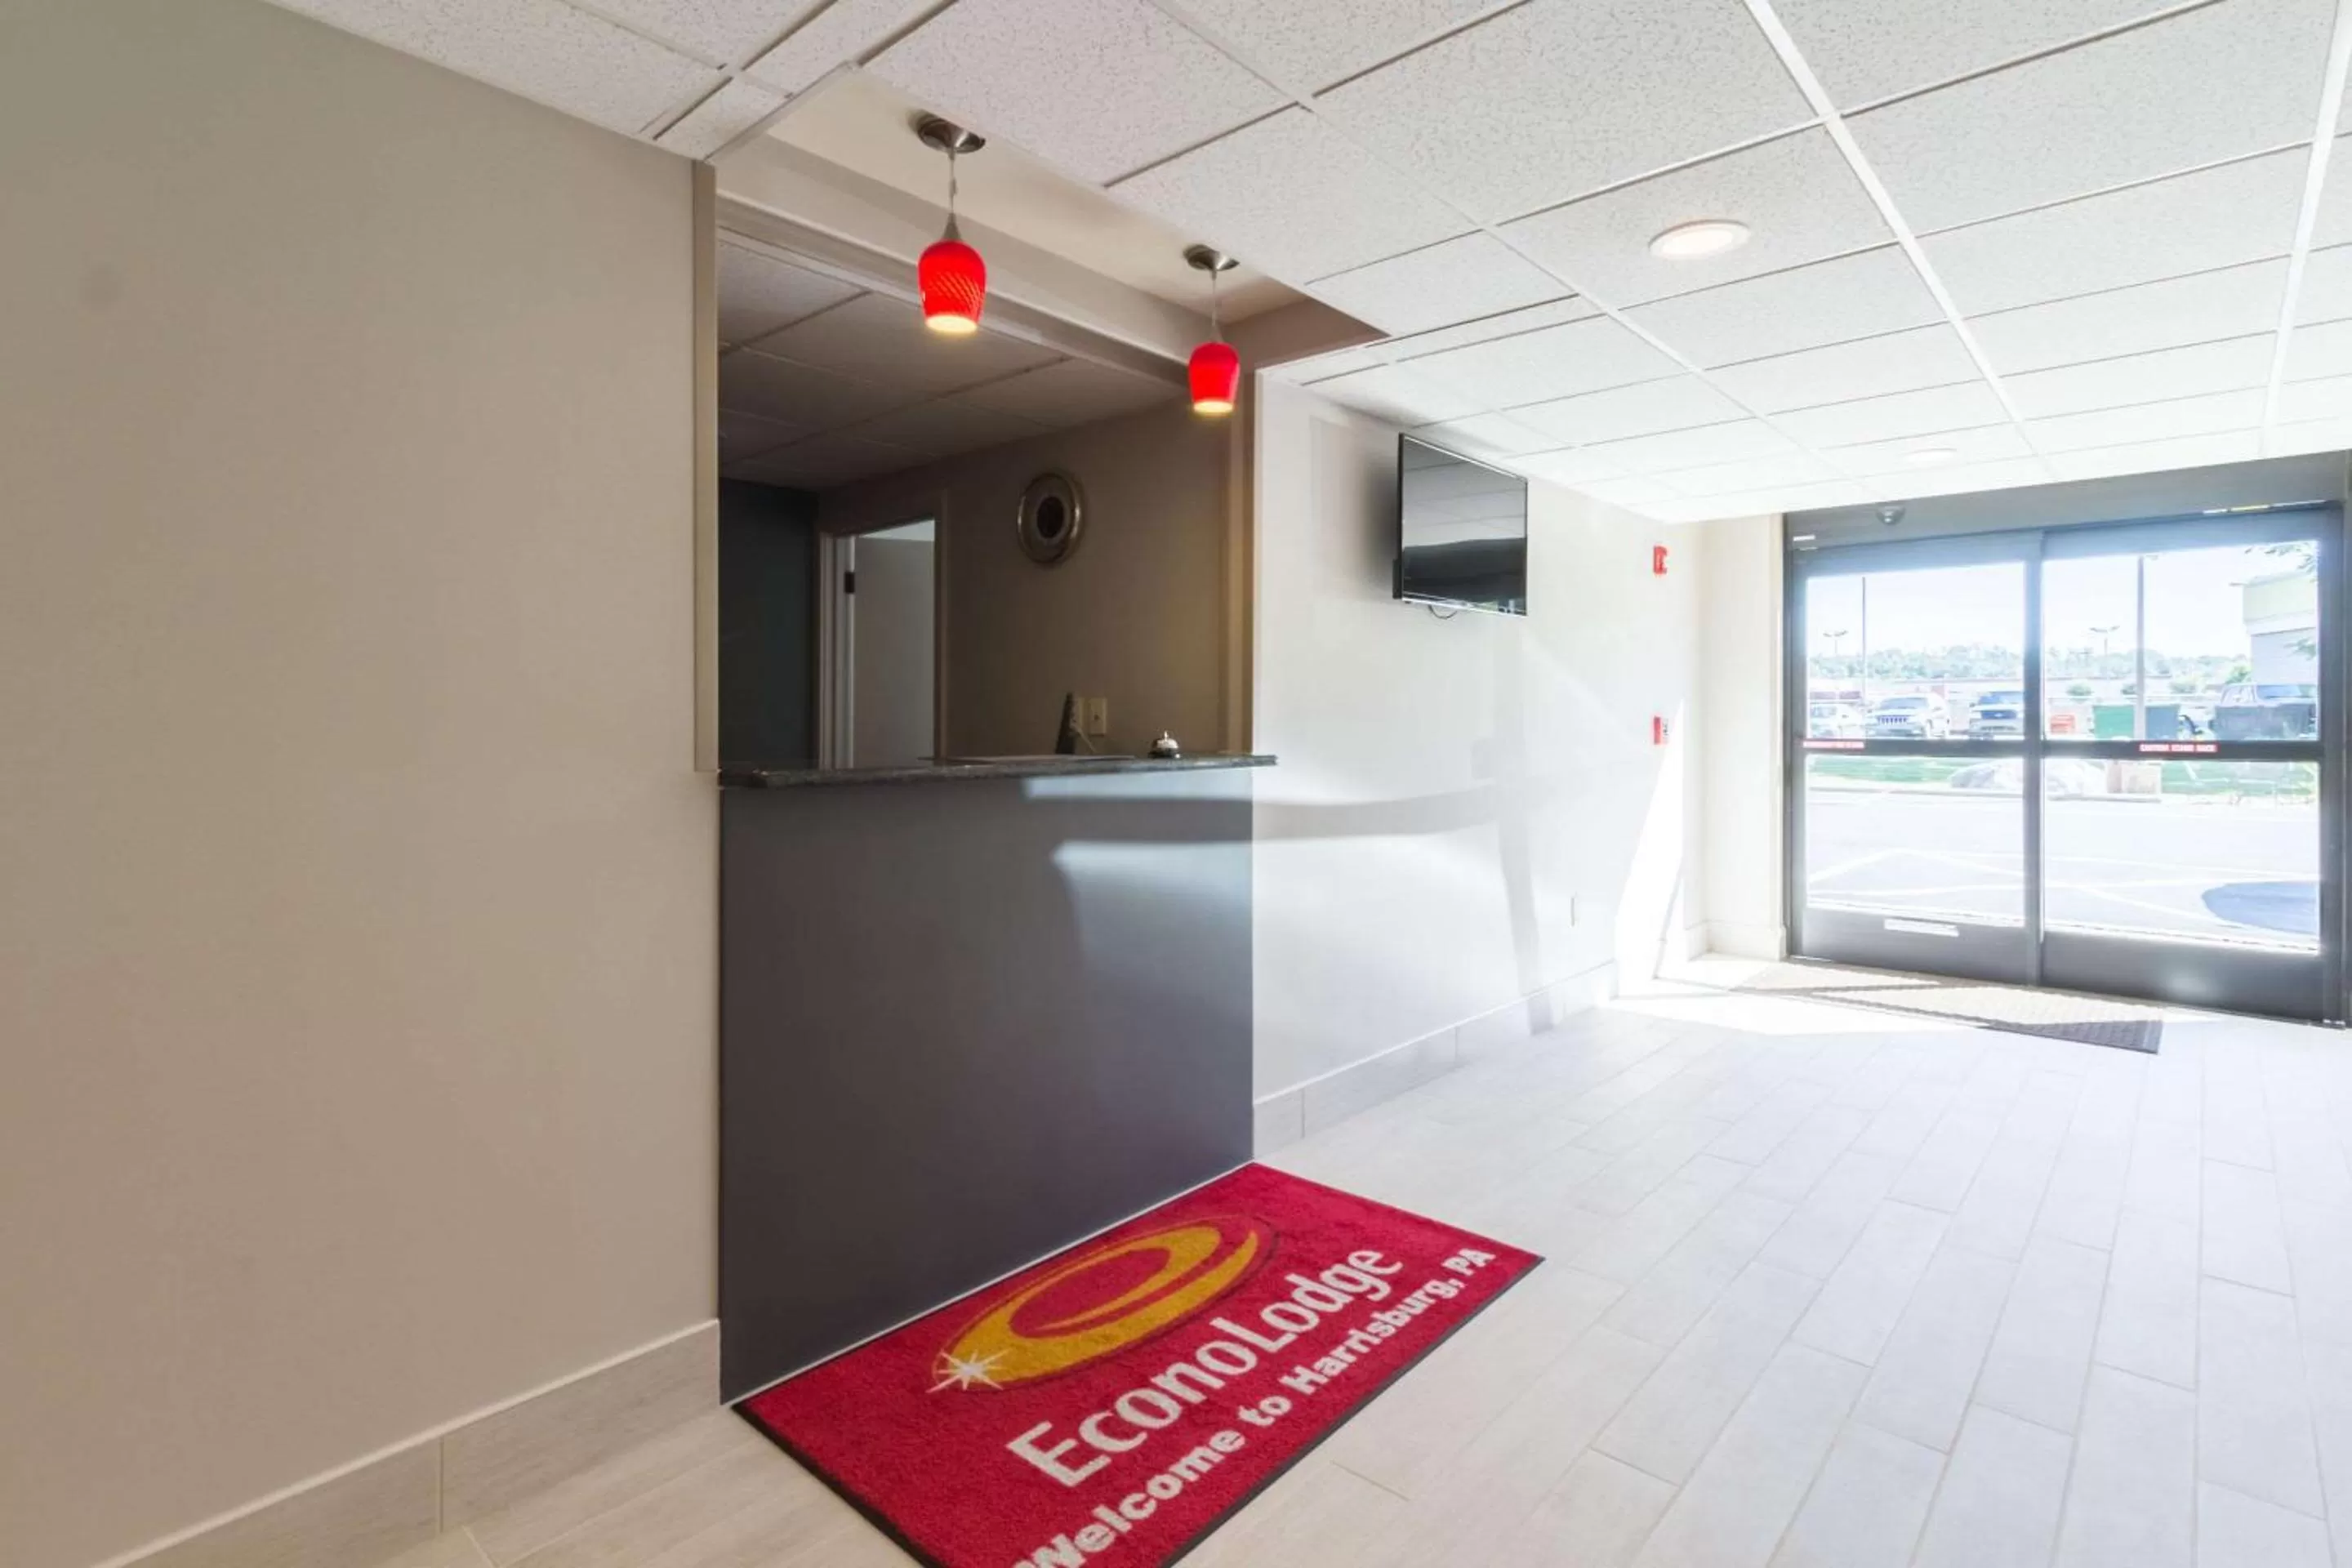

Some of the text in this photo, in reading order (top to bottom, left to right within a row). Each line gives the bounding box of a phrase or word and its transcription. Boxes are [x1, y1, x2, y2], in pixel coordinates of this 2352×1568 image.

[1237, 1395, 1293, 1427] to
[1278, 1278, 1466, 1396] Harrisburg,
[1441, 1247, 1497, 1276] PA
